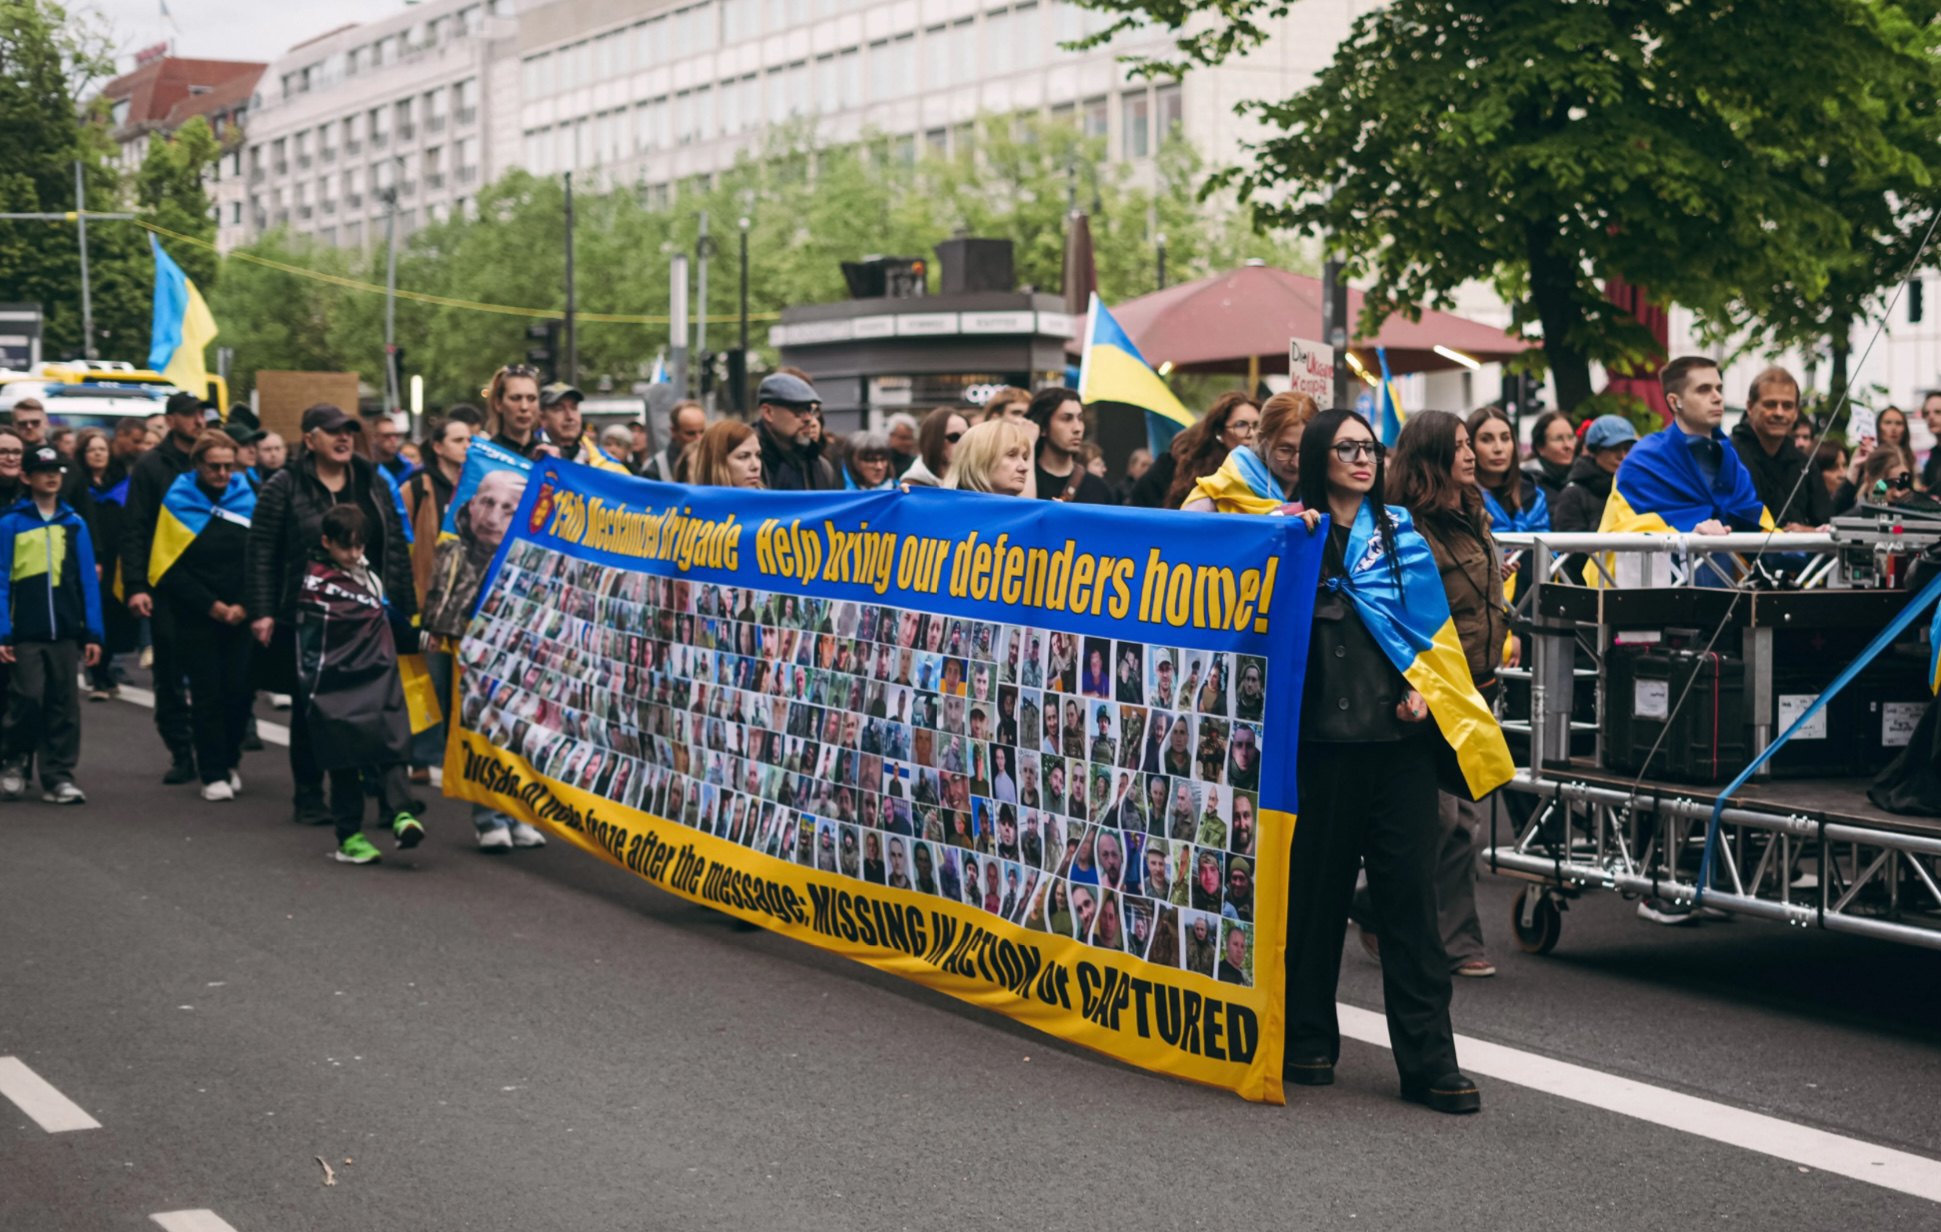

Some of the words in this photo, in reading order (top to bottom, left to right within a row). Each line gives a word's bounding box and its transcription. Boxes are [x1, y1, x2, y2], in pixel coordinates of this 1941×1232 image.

[755, 517, 822, 586] Help
[822, 519, 898, 595] bring
[896, 532, 951, 595] our
[948, 530, 1135, 621] defenders
[1138, 546, 1280, 635] home!
[626, 830, 676, 883] after
[671, 843, 704, 895] the
[702, 860, 810, 928] message:
[806, 881, 927, 959] MISSING
[924, 910, 958, 967] IN
[941, 921, 1042, 1000] ACTION
[1037, 959, 1072, 1011] or
[1075, 960, 1259, 1065] CAPTURED
